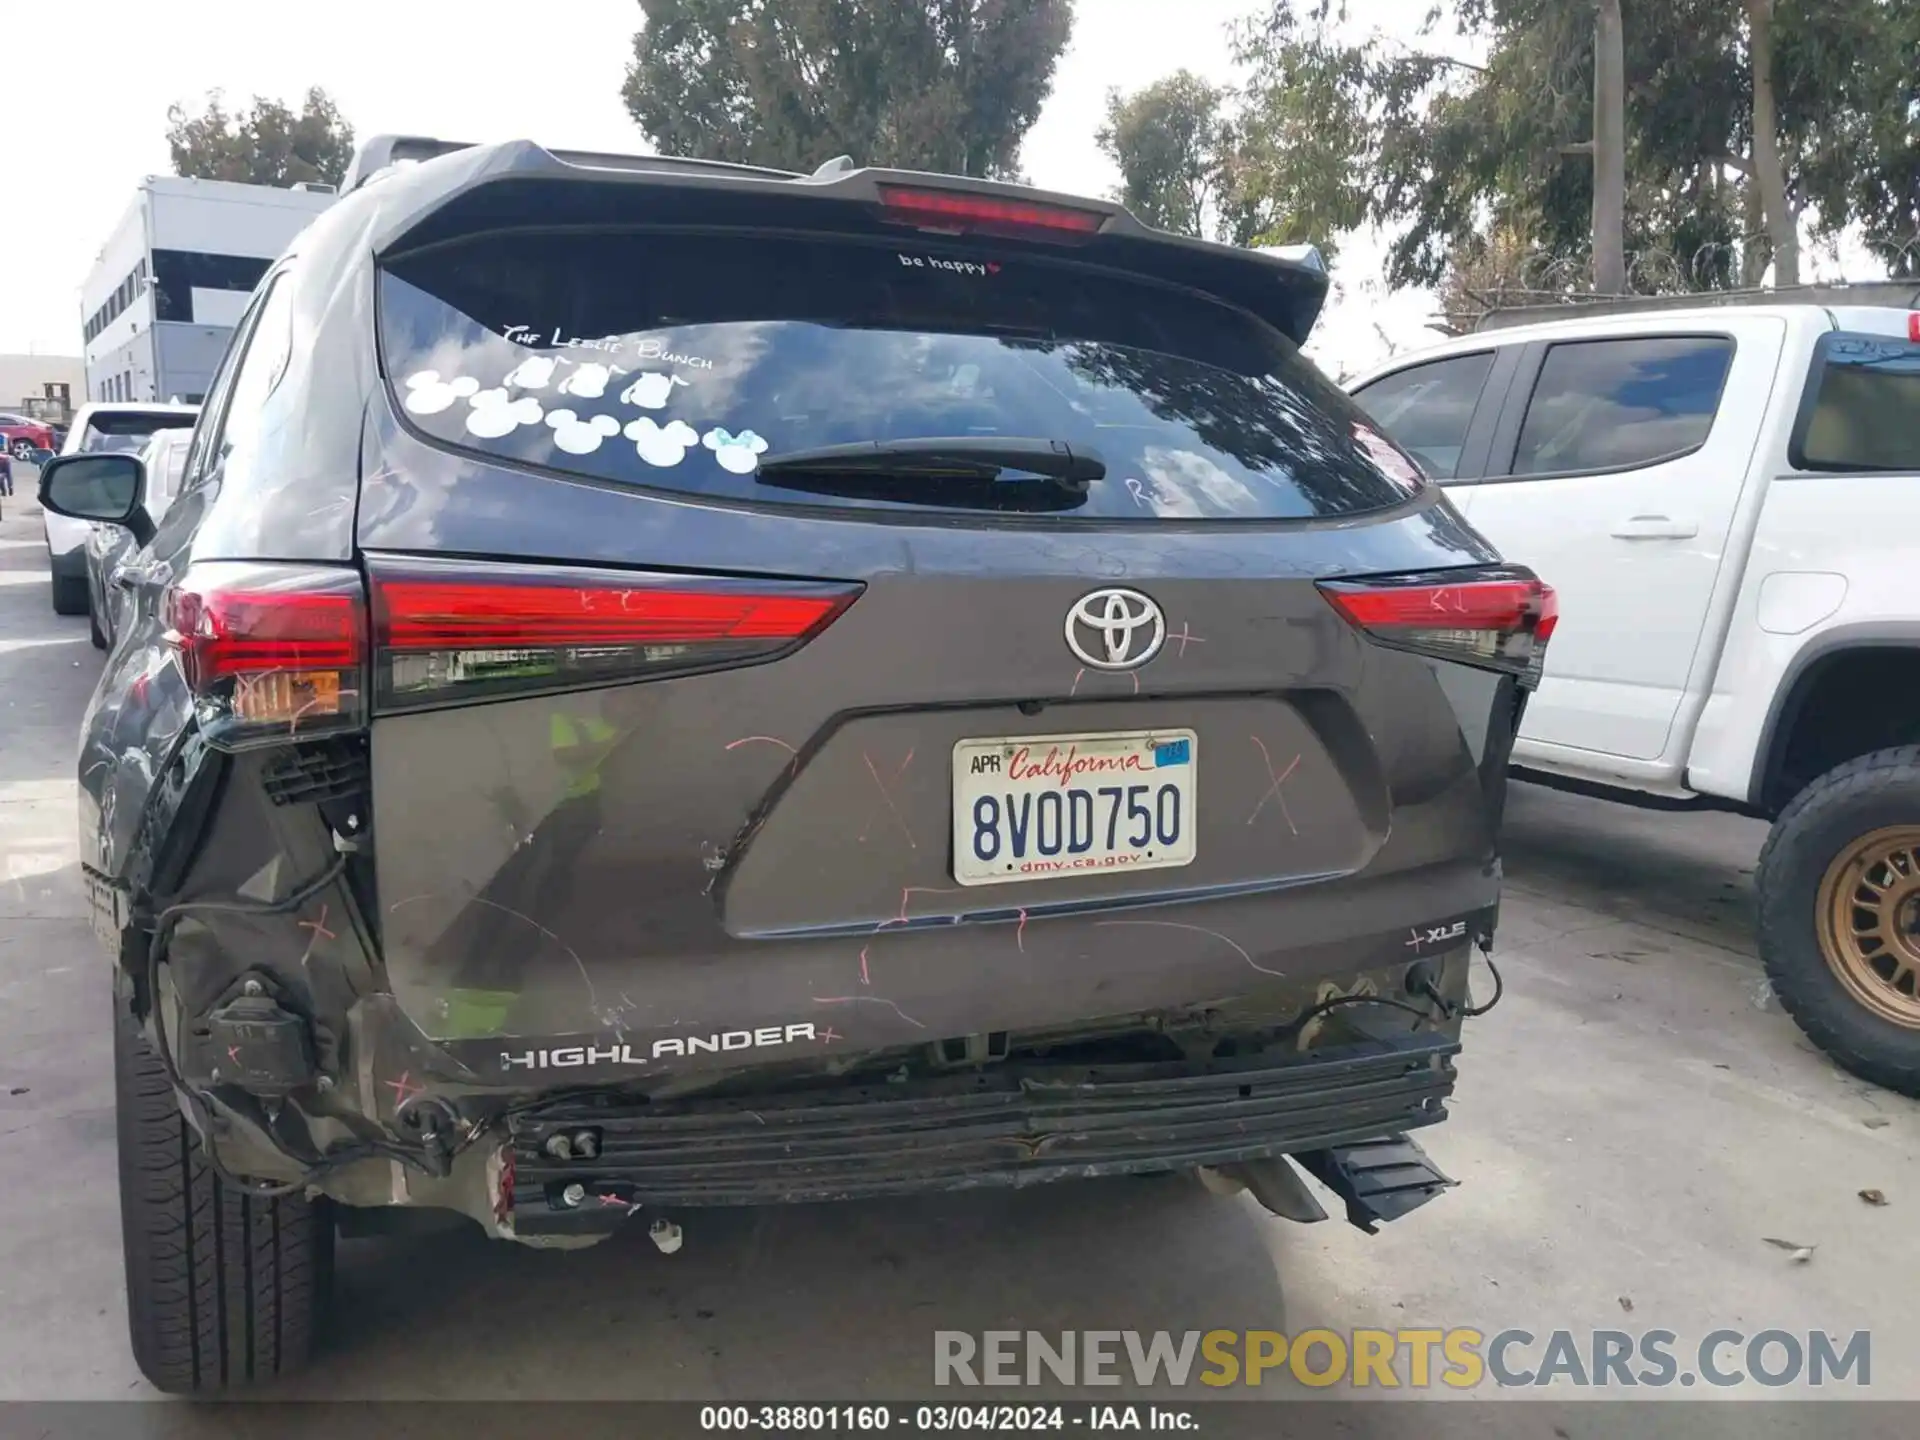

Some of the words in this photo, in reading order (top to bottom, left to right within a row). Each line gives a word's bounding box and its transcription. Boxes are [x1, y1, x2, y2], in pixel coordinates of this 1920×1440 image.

[898, 253, 924, 267] be
[927, 256, 986, 276] happy
[970, 754, 1001, 774] APR
[1008, 746, 1156, 787] California
[973, 783, 1181, 861] 8VOD750
[1019, 853, 1142, 873] dmv.ca.gov
[1427, 921, 1466, 943] XLE
